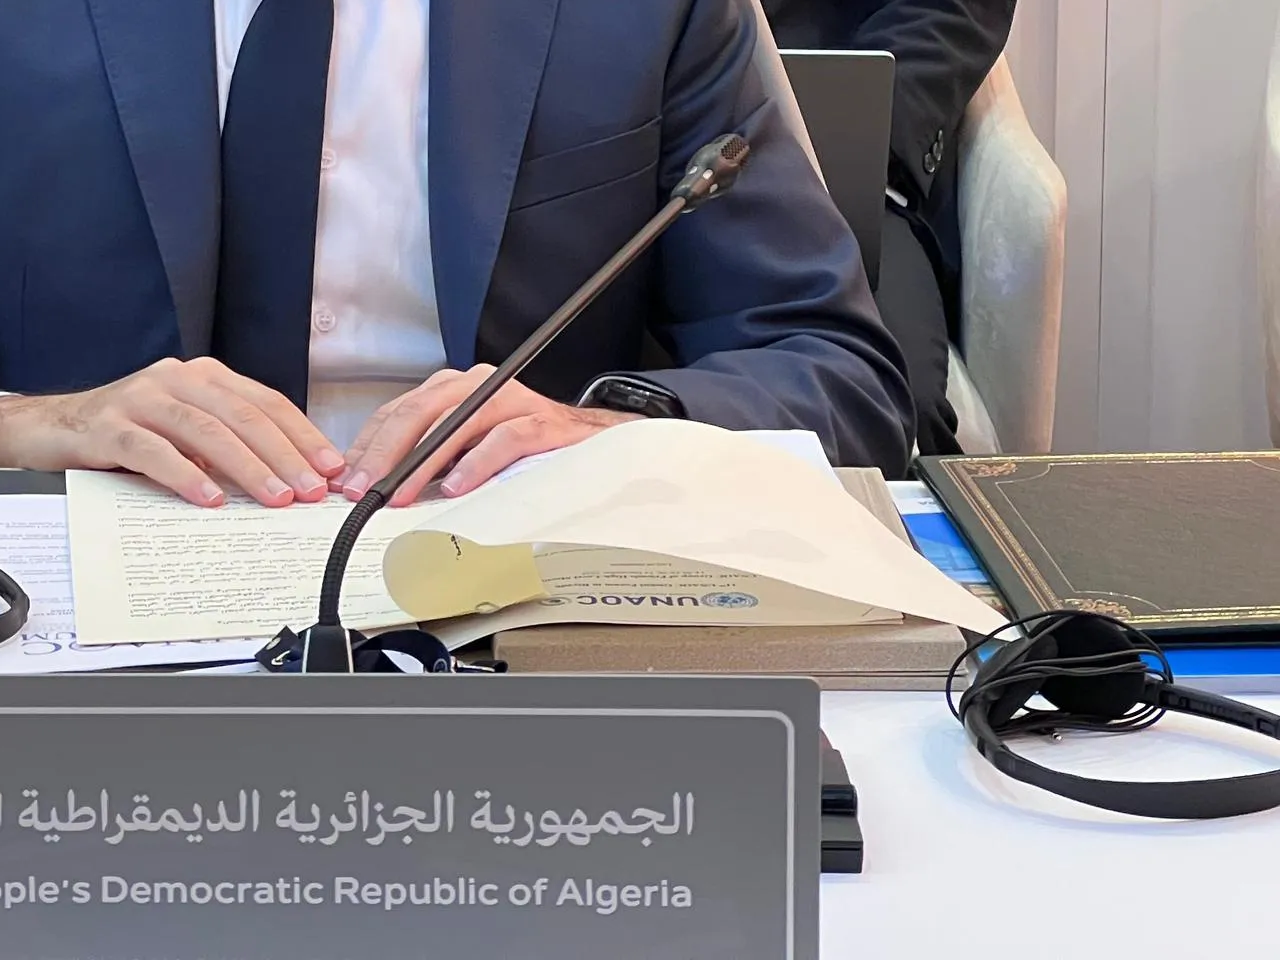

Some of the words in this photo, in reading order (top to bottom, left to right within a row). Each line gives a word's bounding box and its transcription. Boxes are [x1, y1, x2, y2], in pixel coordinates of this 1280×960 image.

[577, 595, 700, 607] UNAOC
[19, 788, 260, 845] الديمقراطية
[275, 789, 454, 846] الجزائرية
[471, 790, 694, 847] الجمهورية
[101, 875, 324, 905] Democratic
[334, 876, 499, 911] Republic
[508, 877, 550, 906] of
[556, 878, 692, 915] Algeria
